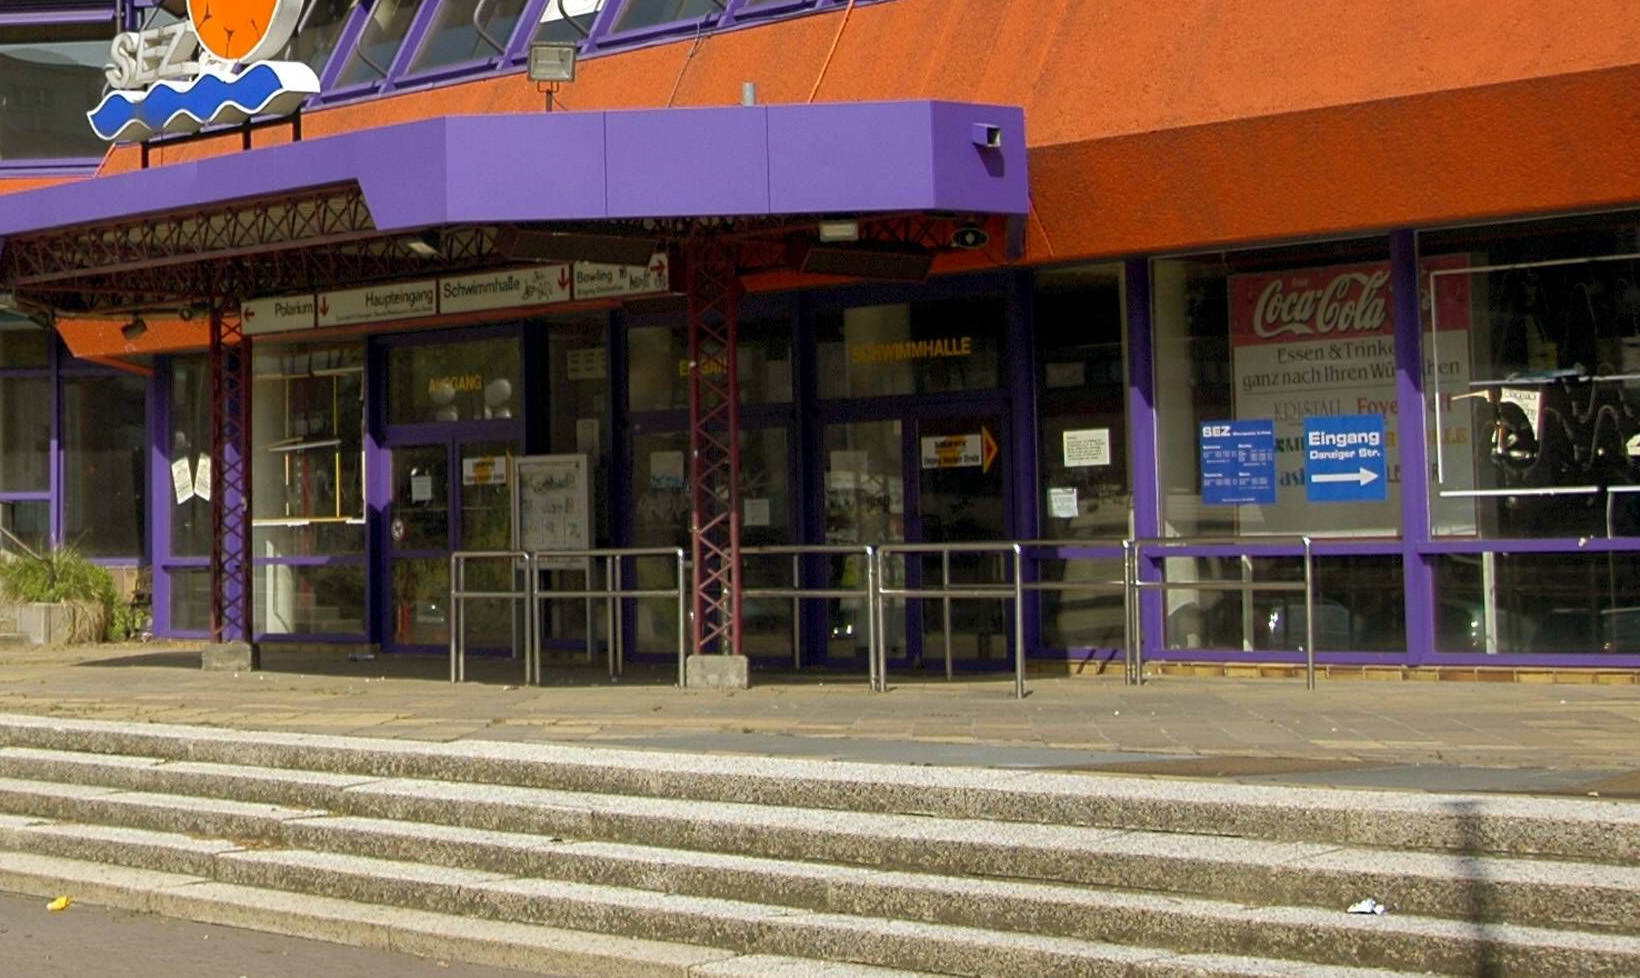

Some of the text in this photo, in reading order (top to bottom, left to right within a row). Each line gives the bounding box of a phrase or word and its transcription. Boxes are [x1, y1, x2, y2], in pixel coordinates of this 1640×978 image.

[104, 22, 200, 89] SEZ
[365, 289, 433, 307] Haupteingang
[443, 276, 520, 298] Schwimmhalle
[577, 269, 613, 285] Bowling
[1253, 270, 1391, 338] Coca-Cola
[850, 336, 973, 363] SCHWIMMHALLE
[1277, 342, 1396, 364] Essen & Trinke
[1242, 374, 1278, 392] ganz
[1282, 368, 1324, 384] nach
[1324, 365, 1368, 382] Ihren
[1308, 431, 1380, 447] Eingang
[1309, 447, 1380, 460] Danziger Str.
